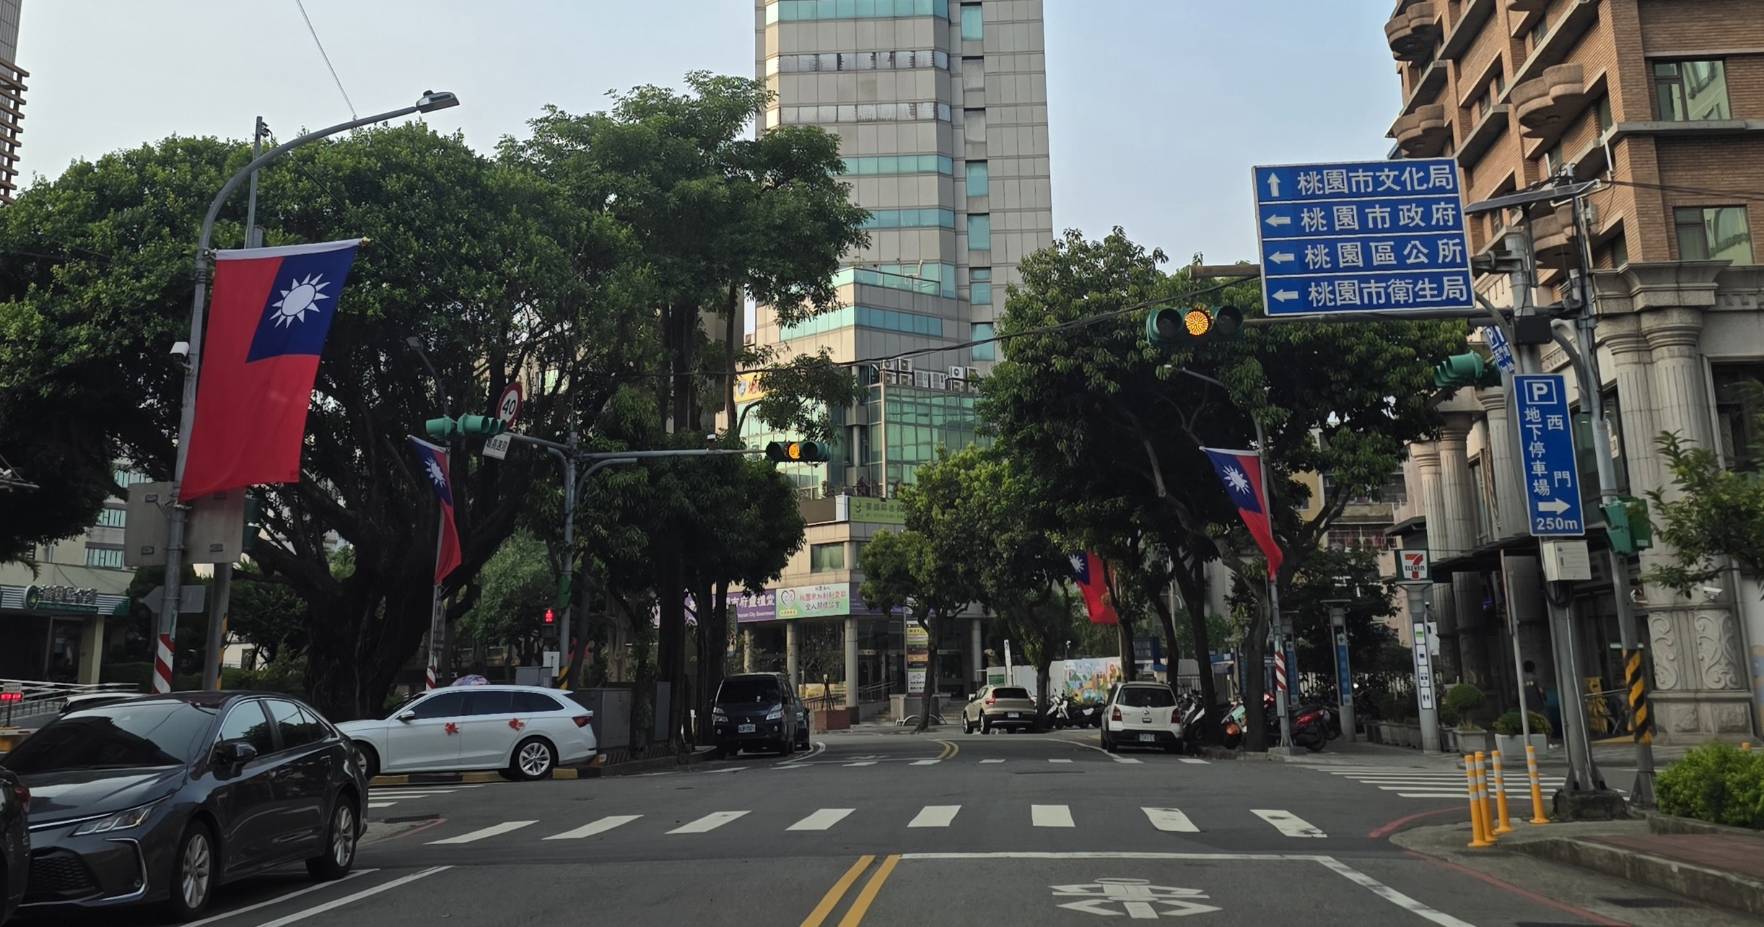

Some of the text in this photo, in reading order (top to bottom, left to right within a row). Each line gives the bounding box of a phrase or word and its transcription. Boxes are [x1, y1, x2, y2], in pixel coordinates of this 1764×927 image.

[1297, 165, 1454, 196] 桃園市文化局
[1301, 202, 1456, 233] 桃園市政府
[1305, 238, 1462, 270] 桃園區公所
[1308, 276, 1467, 307] 桃園市衛生局
[503, 399, 516, 415] 40
[1532, 383, 1548, 401] P
[1524, 407, 1550, 496] 地下停車場
[1546, 414, 1571, 488] 西門
[1536, 518, 1578, 531] 250m
